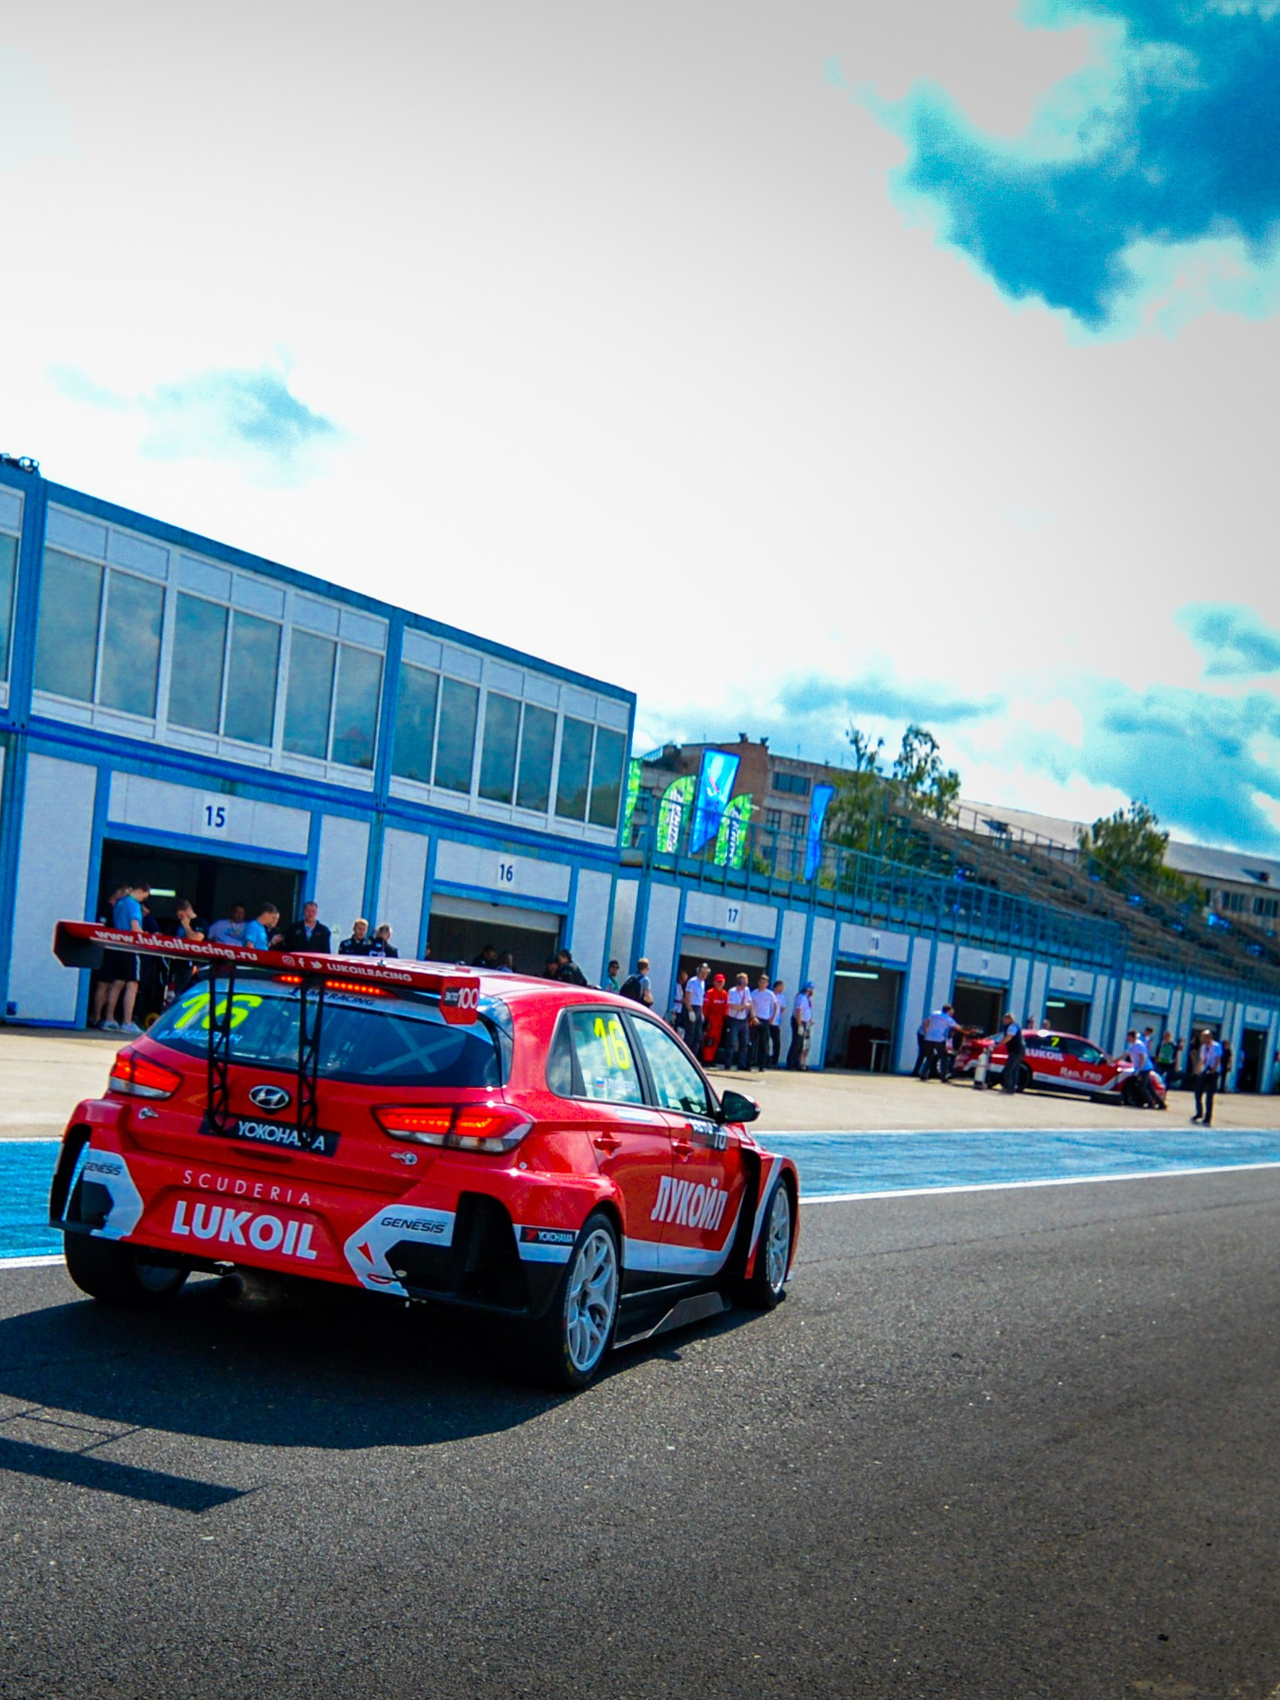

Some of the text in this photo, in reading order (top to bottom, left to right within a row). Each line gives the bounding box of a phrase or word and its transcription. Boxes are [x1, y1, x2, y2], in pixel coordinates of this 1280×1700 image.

[205, 805, 225, 828] 15
[499, 864, 513, 882] 16
[728, 908, 739, 923] 17
[95, 930, 258, 962] www.lukoilracing.ru
[326, 962, 412, 982] LUKOILRACING
[328, 991, 374, 1007] RACING
[457, 987, 479, 1009] 100
[174, 992, 263, 1030] 16
[594, 1017, 631, 1071] 16
[1050, 1036, 1060, 1047] 7
[1025, 1047, 1065, 1062] LUKOIL
[238, 1120, 325, 1151] YOKOHAA
[182, 1169, 311, 1206] SCUDERIA
[650, 1175, 729, 1231] ЛУКОЙЛ
[171, 1199, 318, 1260] LUKOIL
[380, 1217, 446, 1234] GENESIS
[537, 1230, 573, 1244] YOKOHAMA
